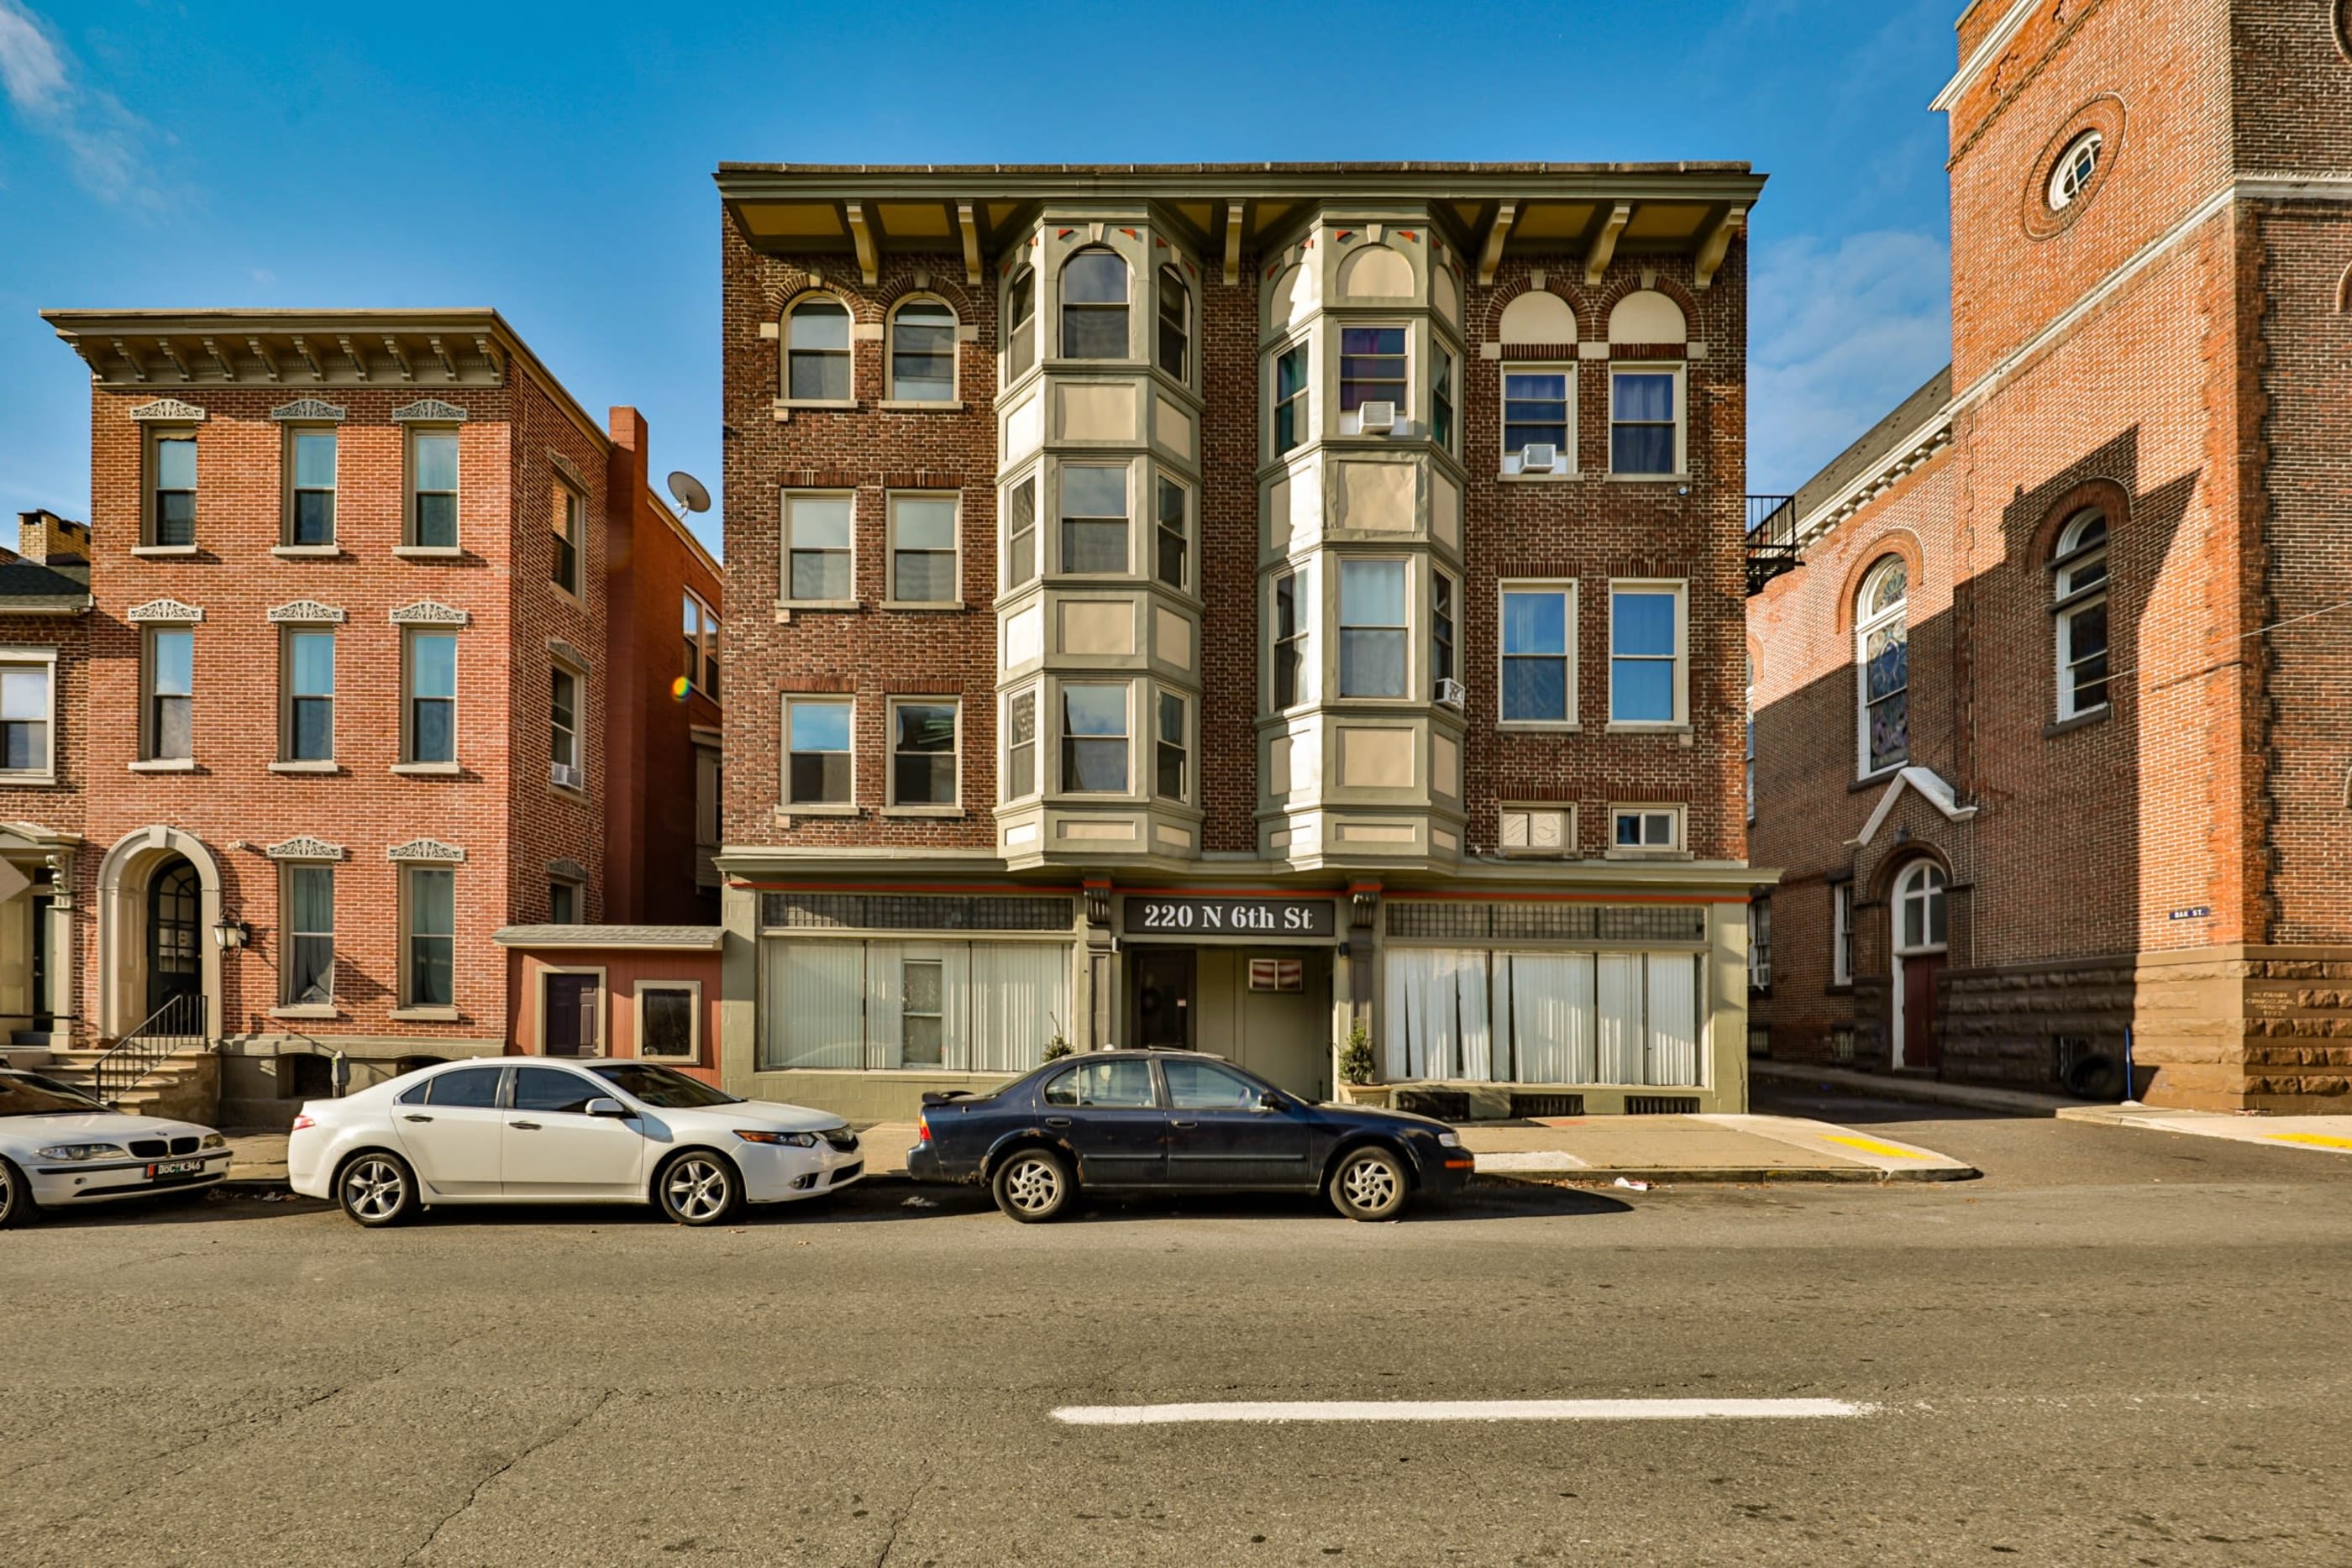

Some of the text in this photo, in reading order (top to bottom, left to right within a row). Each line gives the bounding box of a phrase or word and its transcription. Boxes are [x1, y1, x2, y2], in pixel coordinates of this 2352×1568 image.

[1144, 905, 1314, 930] 220 N 6th St
